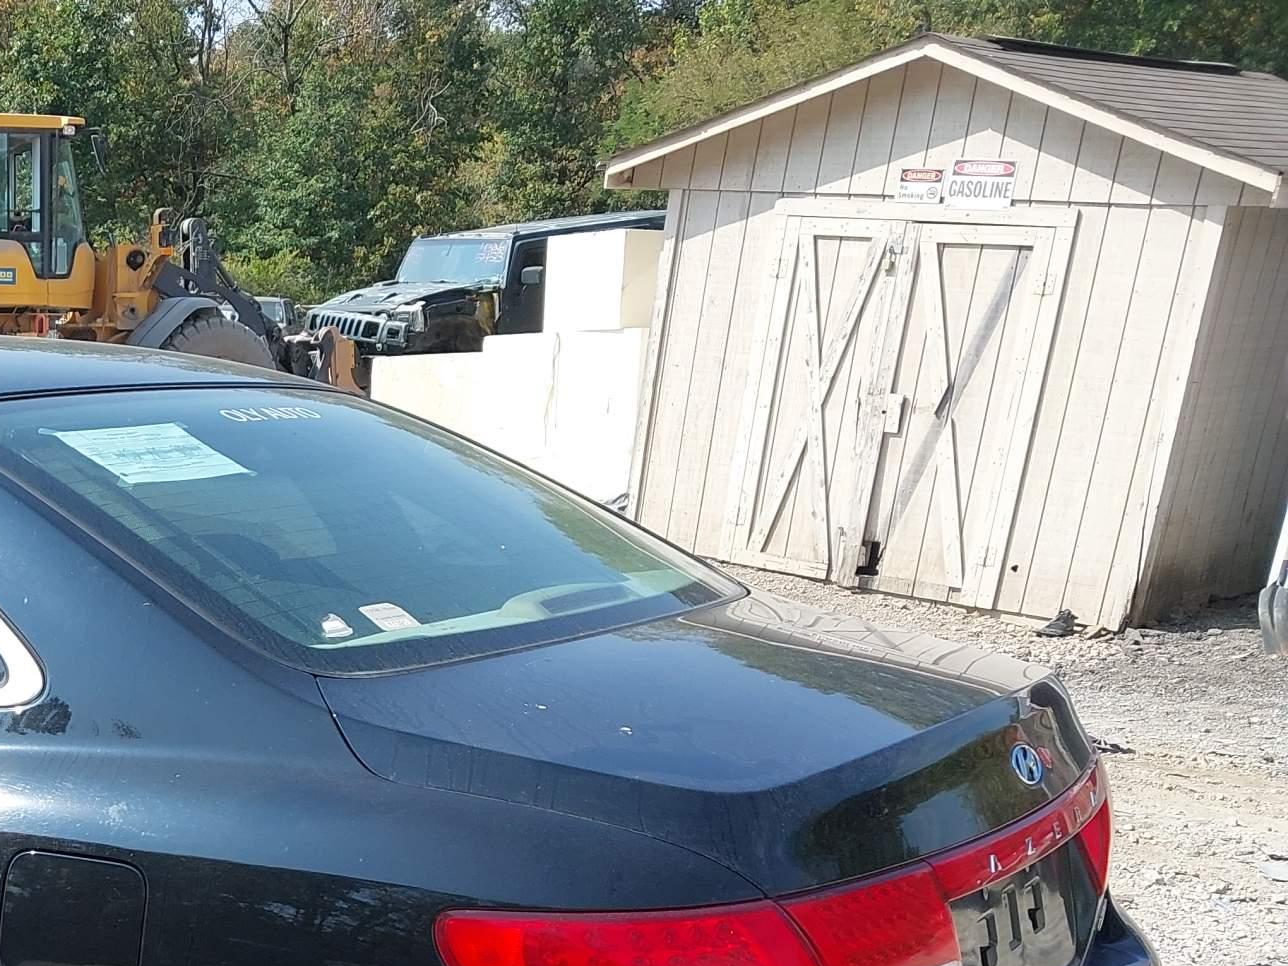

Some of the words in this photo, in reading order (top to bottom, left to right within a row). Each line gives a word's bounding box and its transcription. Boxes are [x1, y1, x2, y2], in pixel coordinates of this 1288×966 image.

[964, 163, 1004, 174] DANGER
[906, 171, 936, 180] DANGER
[948, 180, 1012, 199] GASOLINE
[898, 192, 925, 200] Smoking
[219, 408, 269, 422] OLY
[260, 407, 322, 420] AUTO
